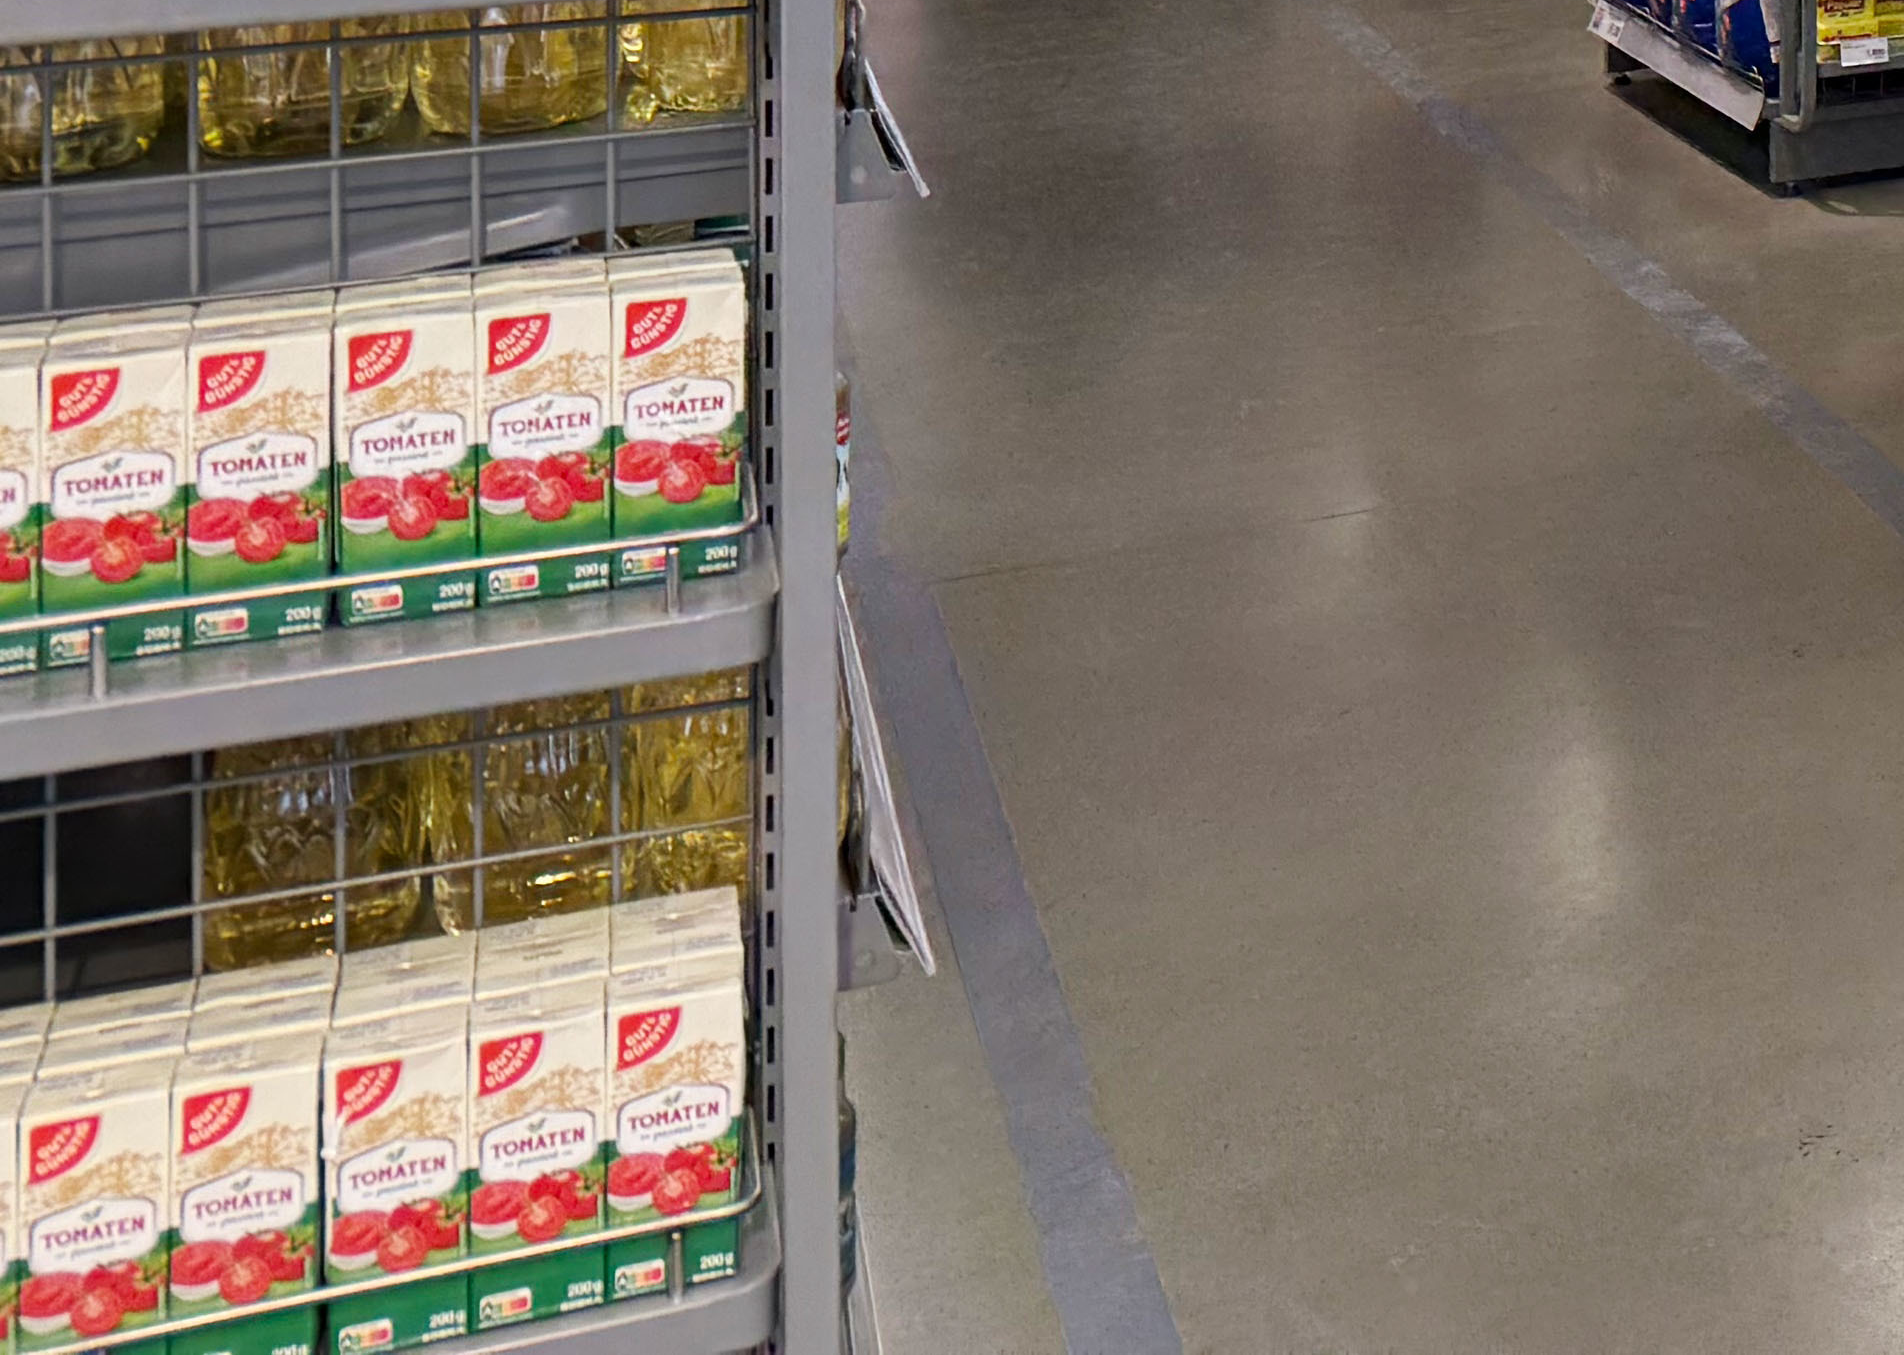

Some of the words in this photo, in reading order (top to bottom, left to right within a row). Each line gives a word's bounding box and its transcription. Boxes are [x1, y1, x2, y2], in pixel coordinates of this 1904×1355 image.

[635, 396, 724, 420] TOMATEN
[499, 412, 592, 436] TOMATEN
[362, 428, 456, 455] TOMATEN
[211, 452, 307, 477] TOMATEN
[64, 469, 165, 496] TOMATEN
[627, 1102, 720, 1131] TOMATEN
[490, 1128, 586, 1158] TOMATEN
[349, 1157, 447, 1190] TOMATEN
[194, 1188, 293, 1218] TOMATEN
[42, 1217, 145, 1249] TOMATEN
